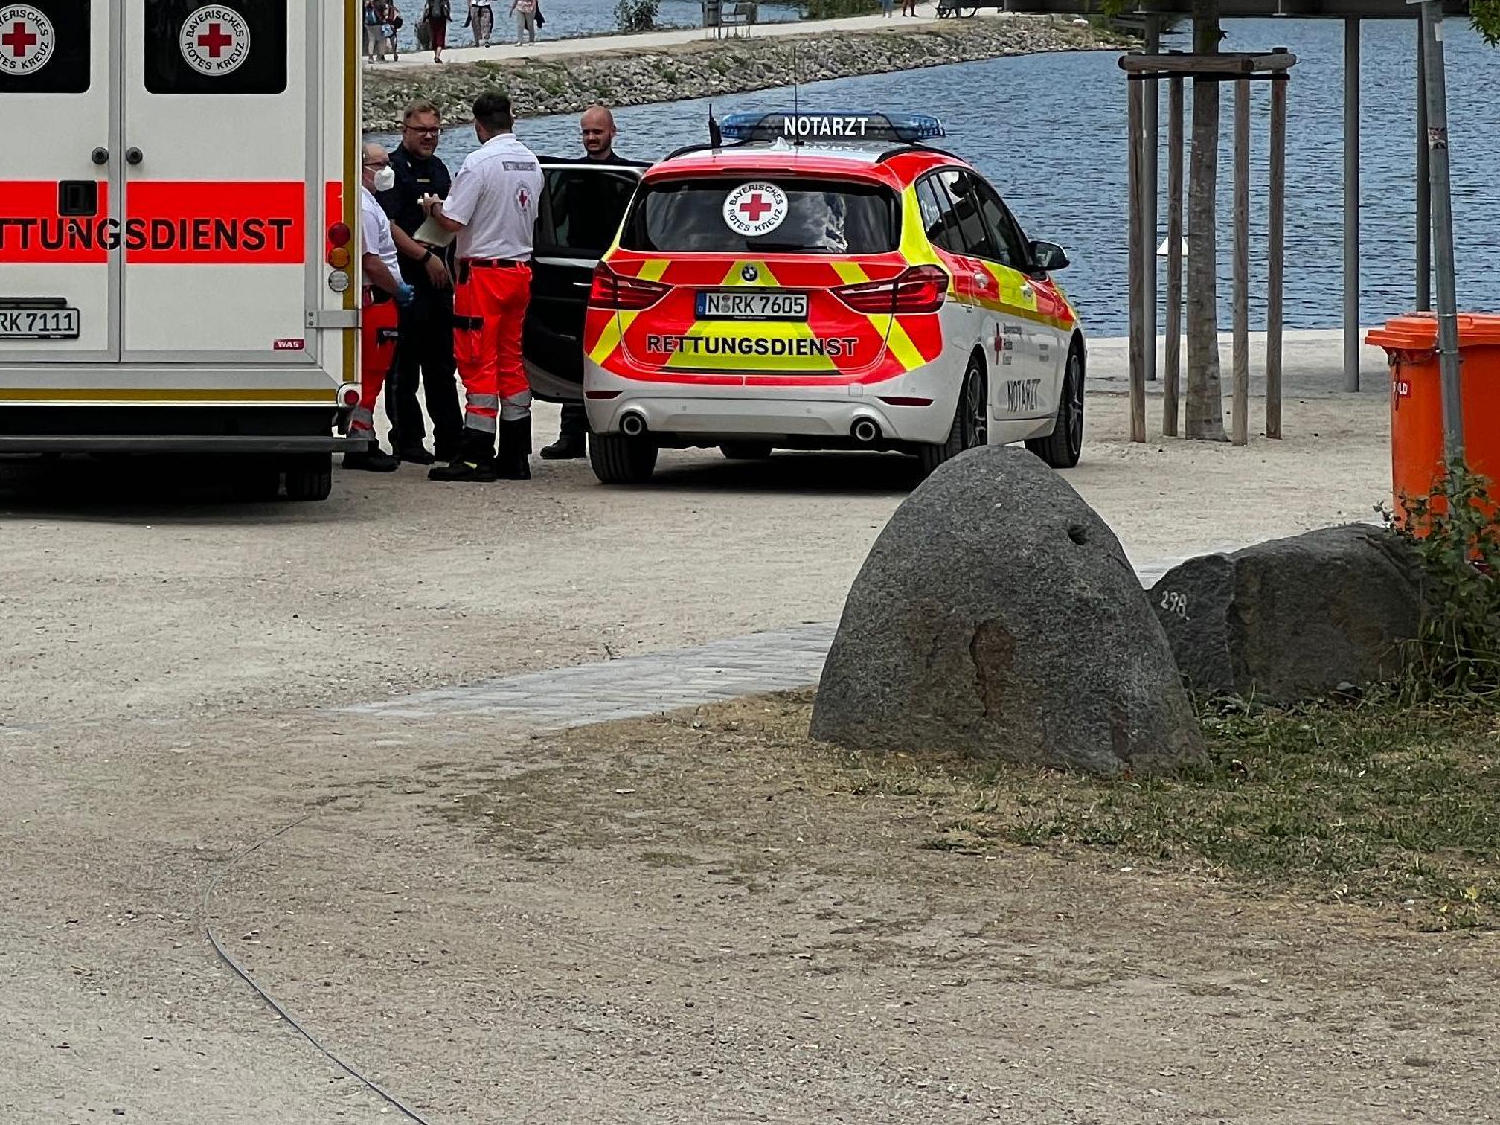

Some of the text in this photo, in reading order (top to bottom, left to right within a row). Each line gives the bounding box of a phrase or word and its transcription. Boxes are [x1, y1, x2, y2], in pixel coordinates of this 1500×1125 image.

[185, 9, 244, 38] BAYERISCHES
[20, 41, 49, 69] KREUZ
[184, 41, 245, 70] ROTES KREUZ
[783, 116, 869, 136] NOTARZT
[728, 183, 784, 206] BAYERISCHES
[727, 208, 783, 232] ROTES KREUZ
[708, 295, 720, 313] N
[731, 295, 755, 314] RK
[759, 296, 805, 314] 7605
[25, 312, 75, 332] 7111
[646, 334, 859, 357] RETTUNGSDIENST
